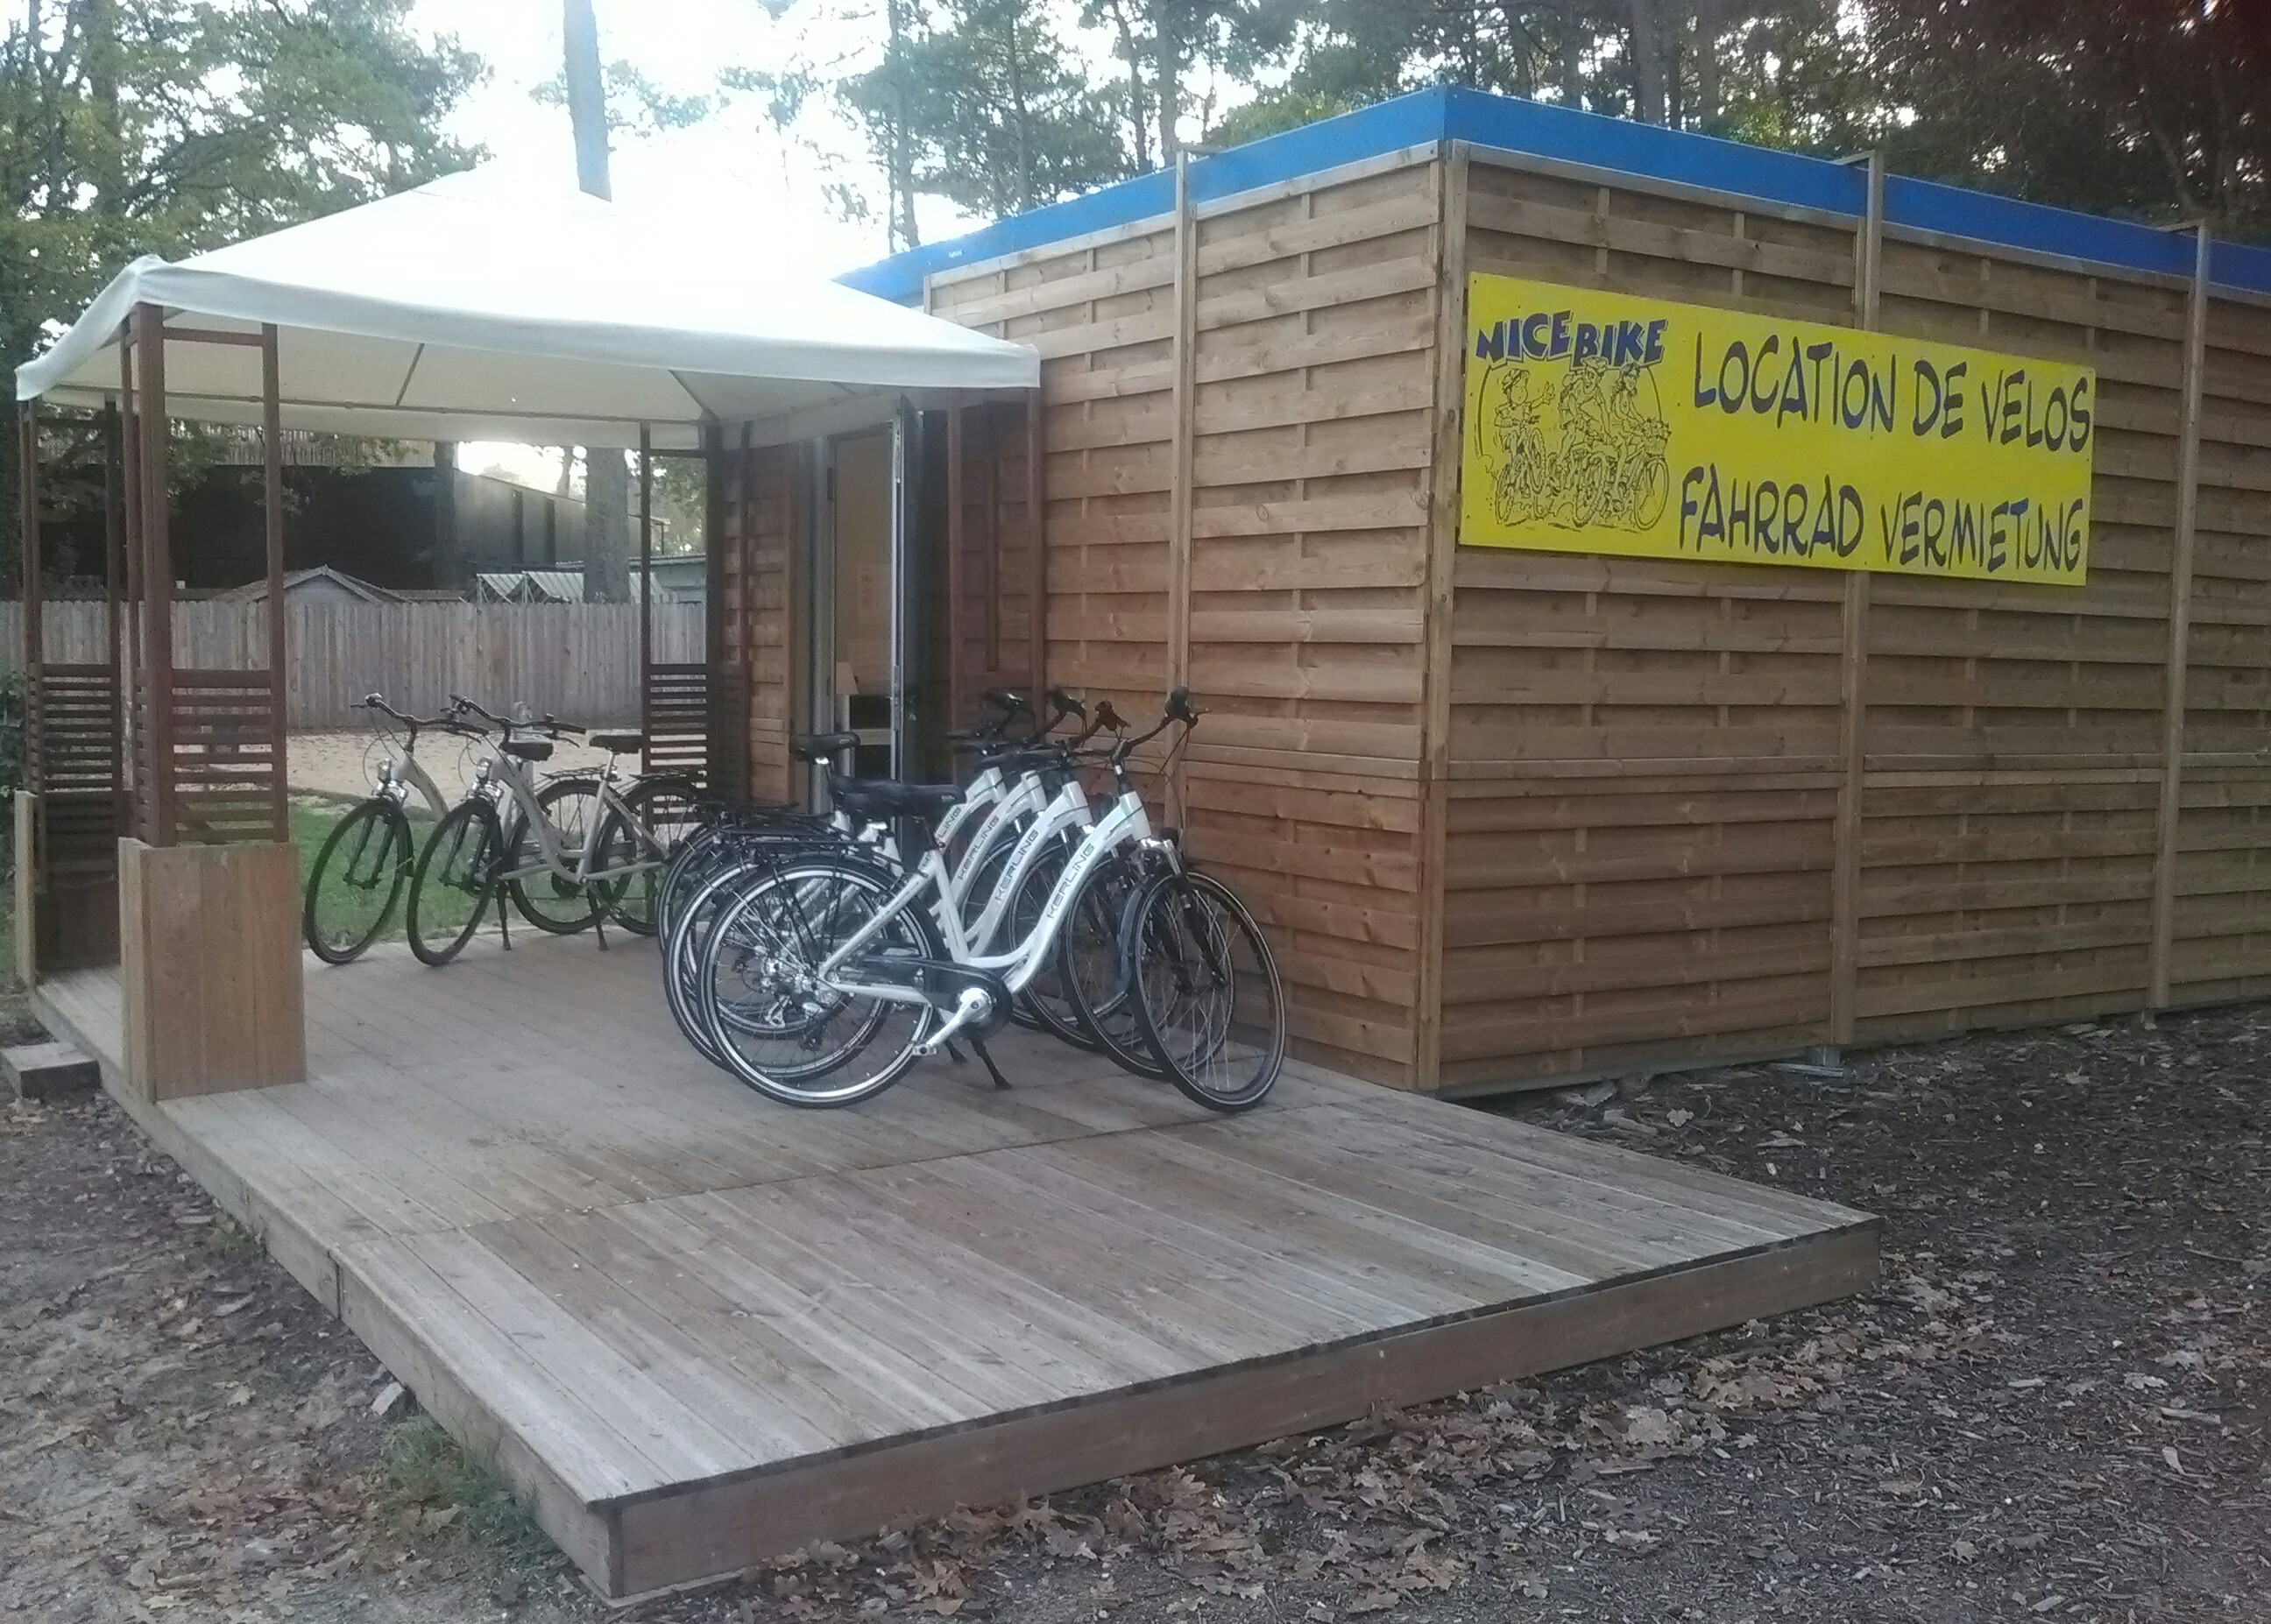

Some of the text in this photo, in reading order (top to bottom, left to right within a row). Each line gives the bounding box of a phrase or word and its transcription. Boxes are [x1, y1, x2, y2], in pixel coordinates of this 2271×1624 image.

[1475, 310, 1668, 368] NICE BIKE
[1694, 331, 2091, 453] LOCATION DE VELOS
[1680, 462, 2084, 573] FAHRRAD VERMIETUNG
